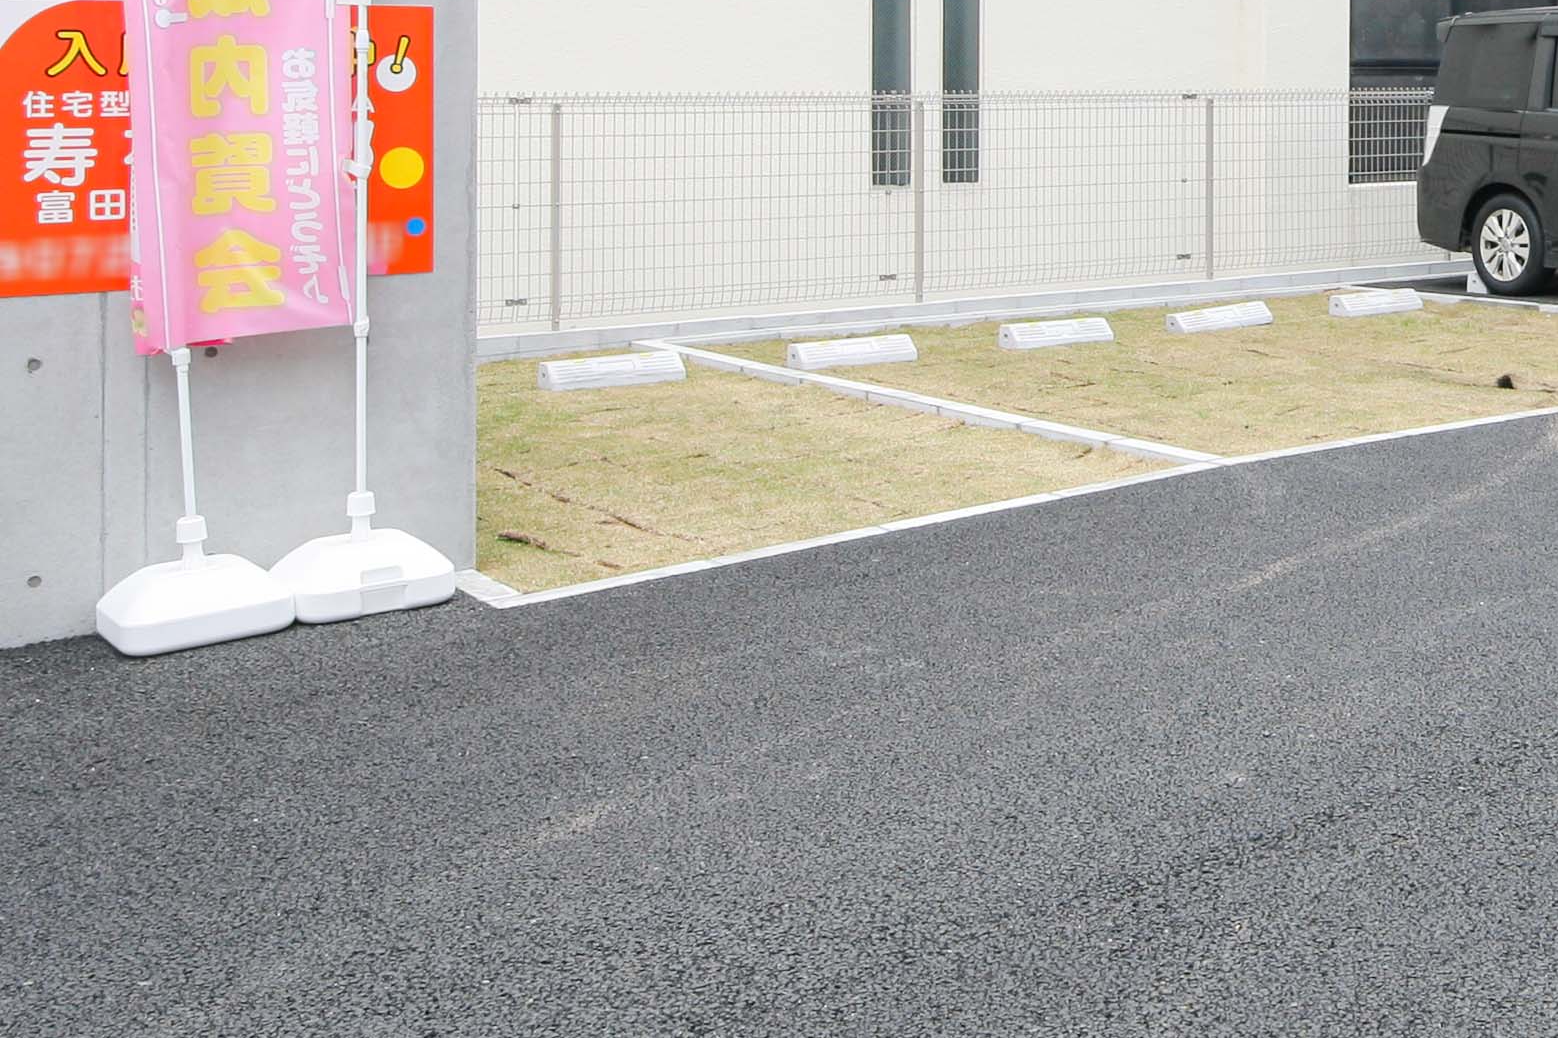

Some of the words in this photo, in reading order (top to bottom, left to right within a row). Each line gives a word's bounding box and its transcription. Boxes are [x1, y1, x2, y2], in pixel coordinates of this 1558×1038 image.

[46, 29, 129, 77] 入
[23, 122, 135, 187] 寿
[36, 190, 126, 224] 富田
